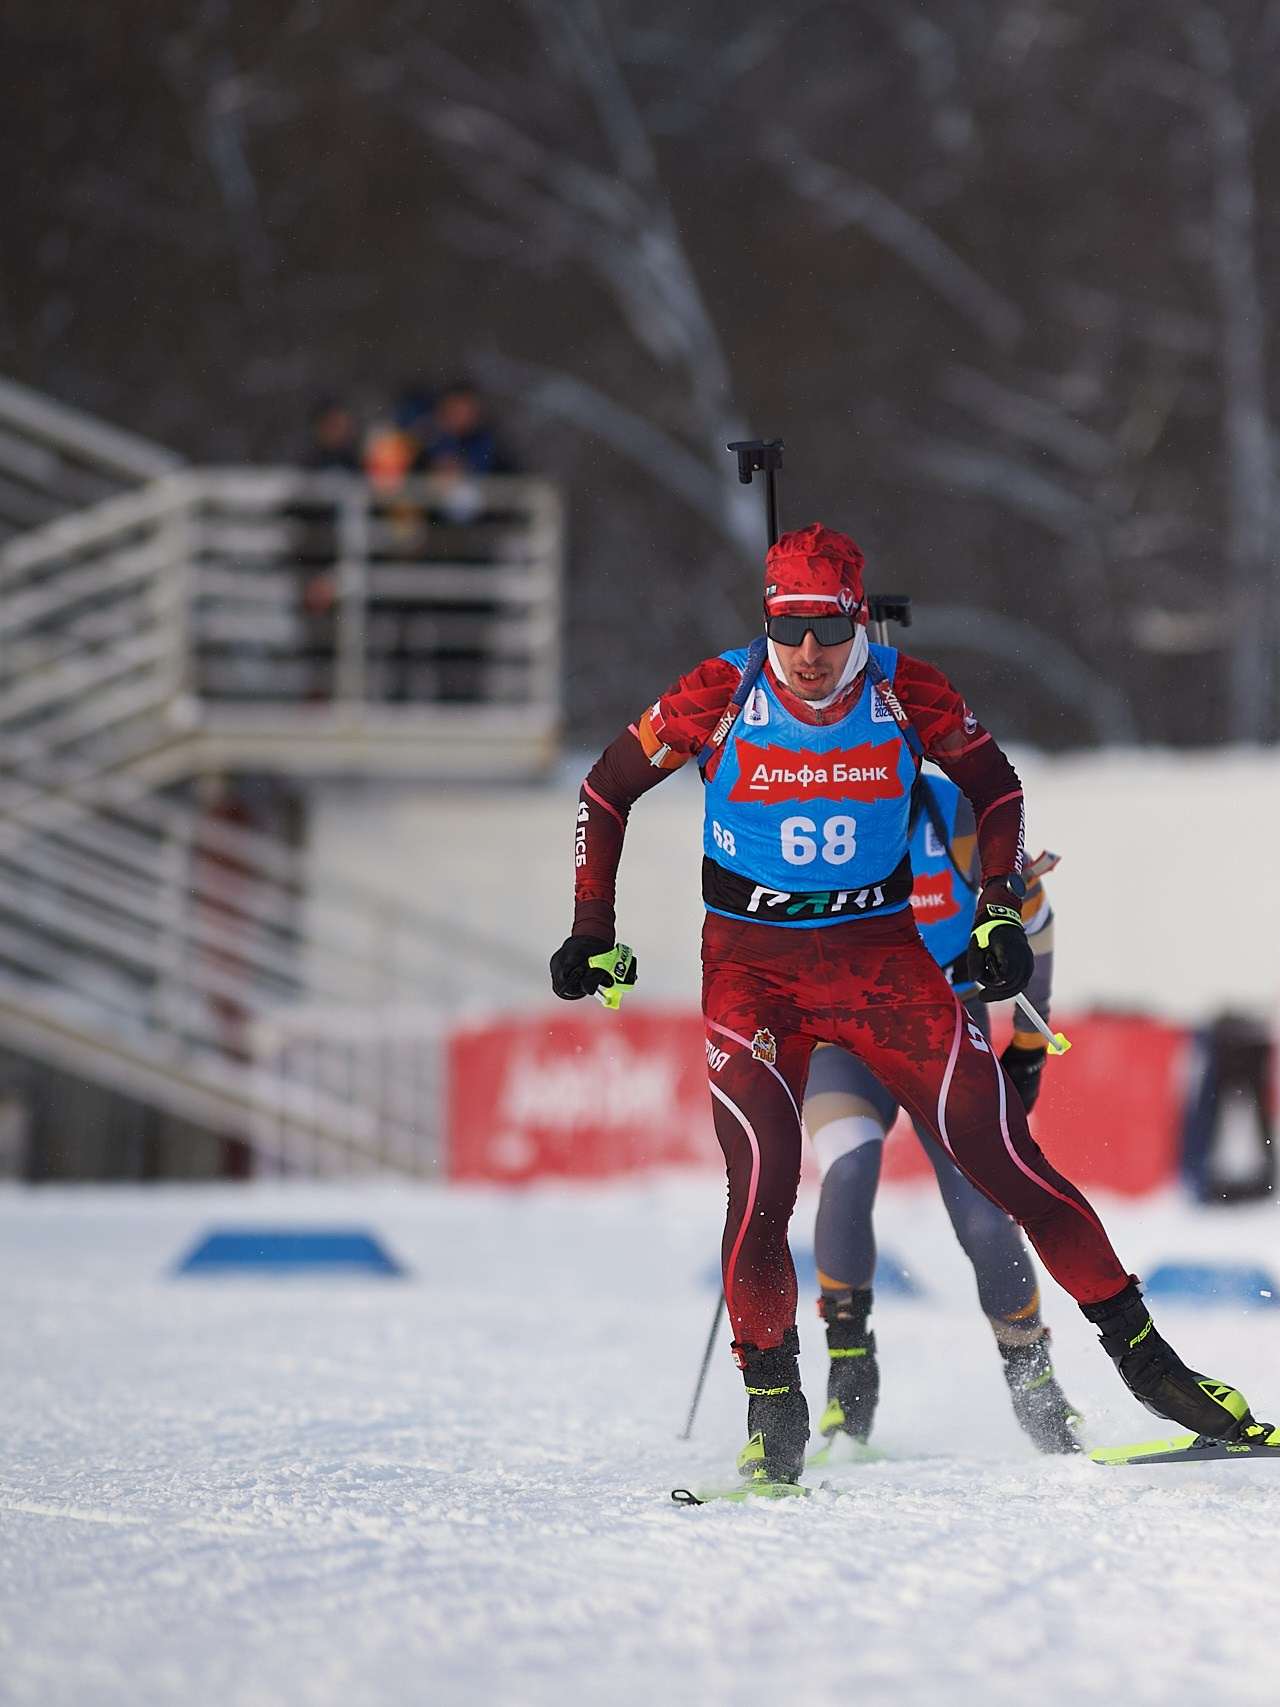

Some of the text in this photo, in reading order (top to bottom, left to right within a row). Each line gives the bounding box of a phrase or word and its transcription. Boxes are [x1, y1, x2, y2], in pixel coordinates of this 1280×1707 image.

[881, 686, 909, 722] swix
[712, 711, 737, 747] swix
[751, 763, 889, 787] Альфа Банк
[575, 826, 588, 868] ПСБ
[712, 820, 737, 857] 68
[780, 815, 857, 865] 68
[746, 884, 887, 915] PARI
[1226, 1445, 1253, 1453] FISCHER
